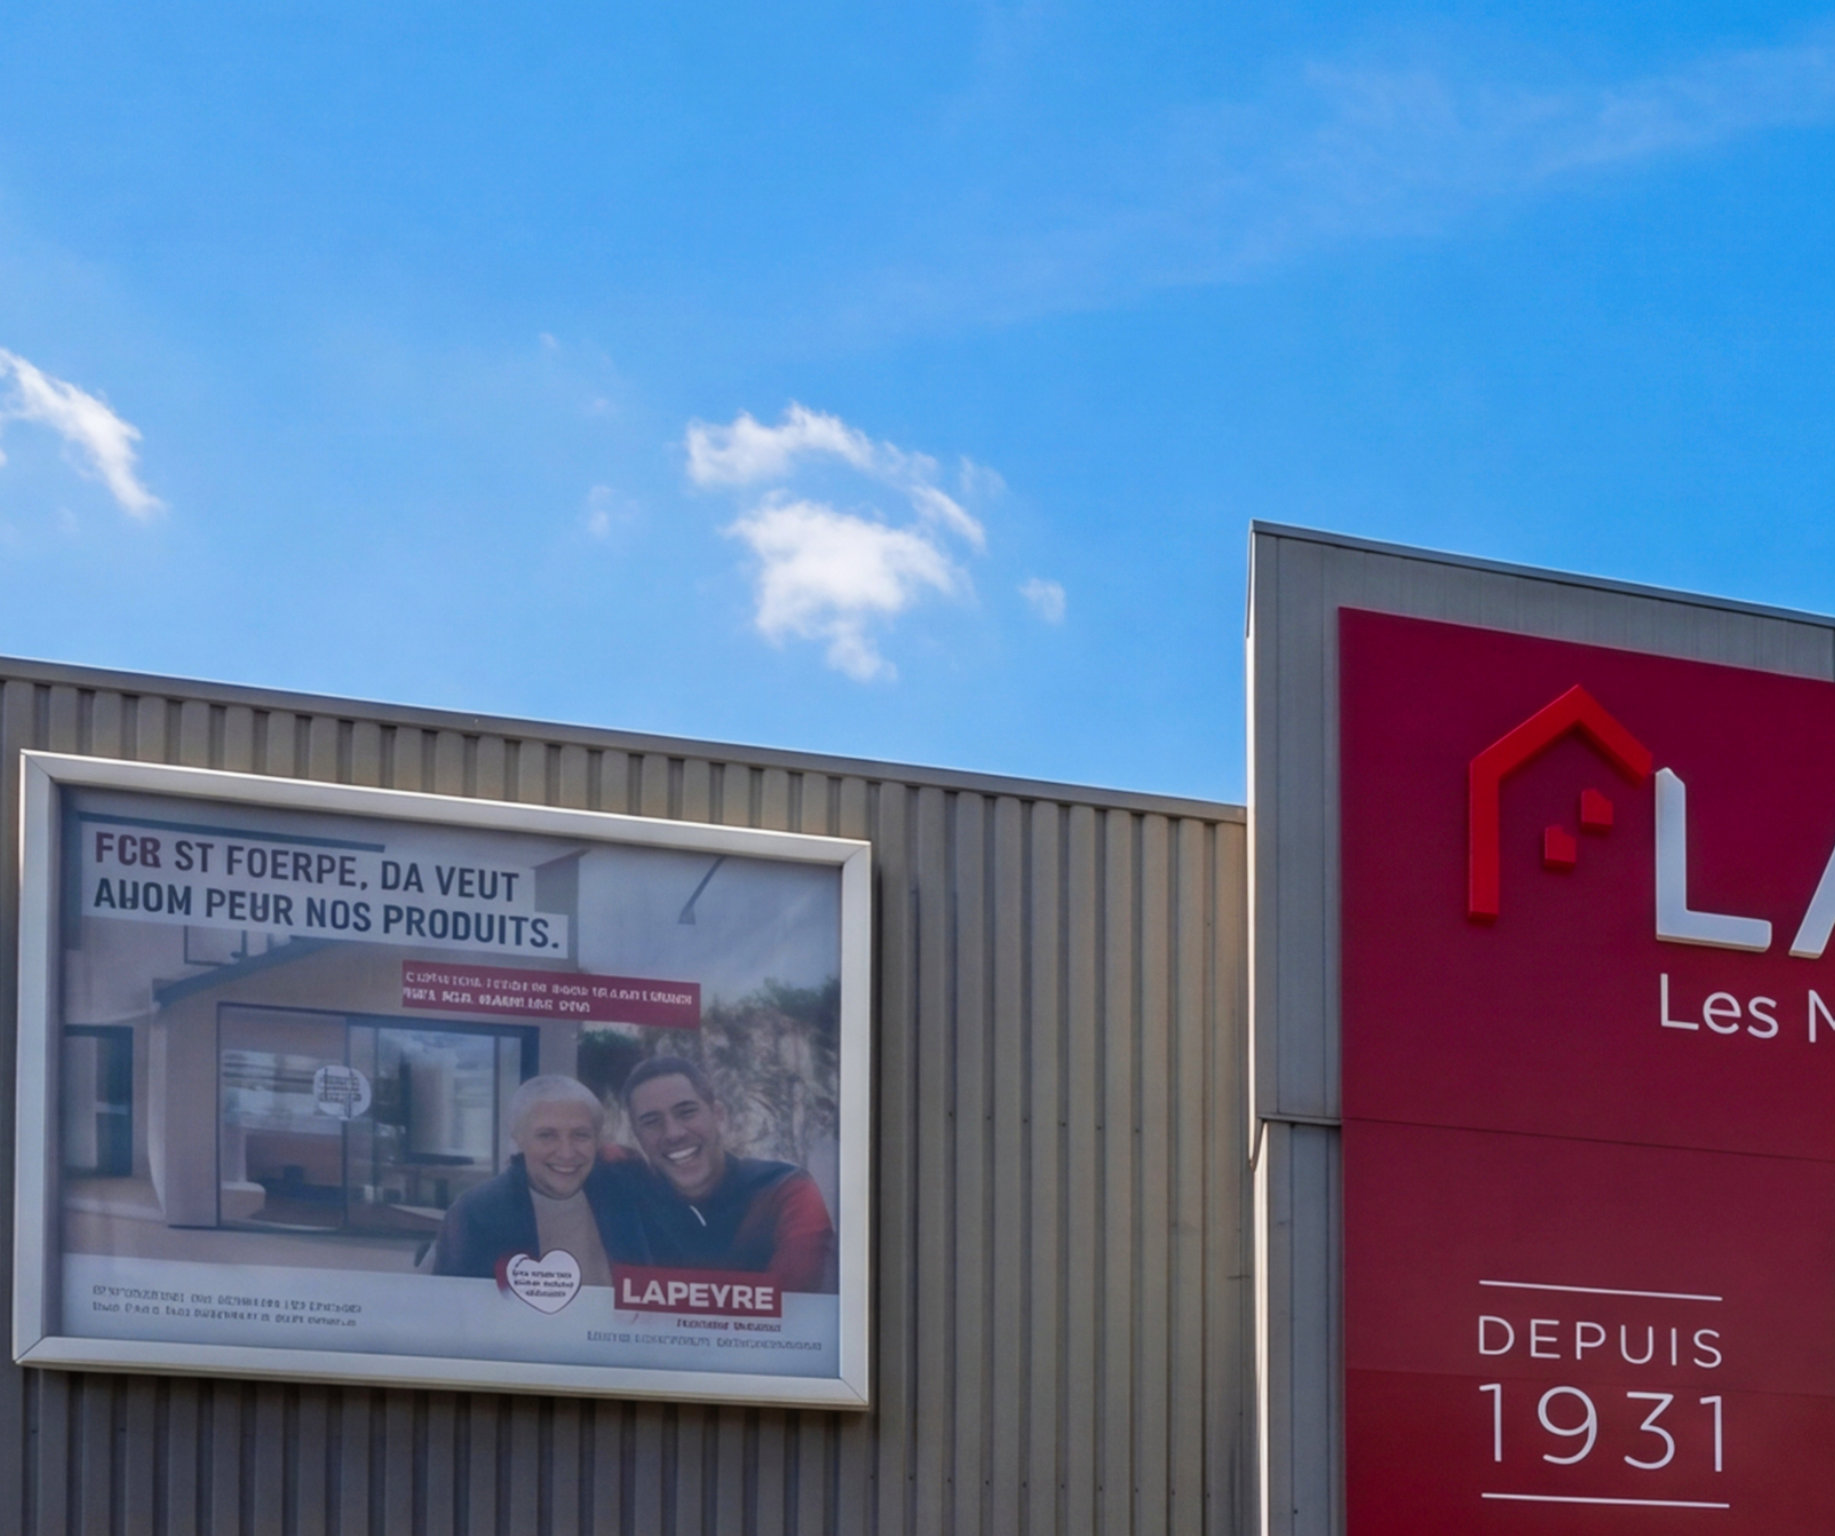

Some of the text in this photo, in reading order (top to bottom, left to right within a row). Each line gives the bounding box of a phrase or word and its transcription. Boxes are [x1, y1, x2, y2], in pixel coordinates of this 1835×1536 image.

[175, 840, 215, 873] ST
[381, 860, 424, 894] DA
[435, 865, 519, 902] VEUT
[306, 897, 372, 932] NOS
[383, 904, 560, 949] PRODUITS.
[1660, 972, 1779, 1040] Les
[622, 1278, 775, 1311] LAPEYRE
[1479, 1315, 1722, 1369] DEPUIS
[1479, 1383, 1723, 1472] 1931
